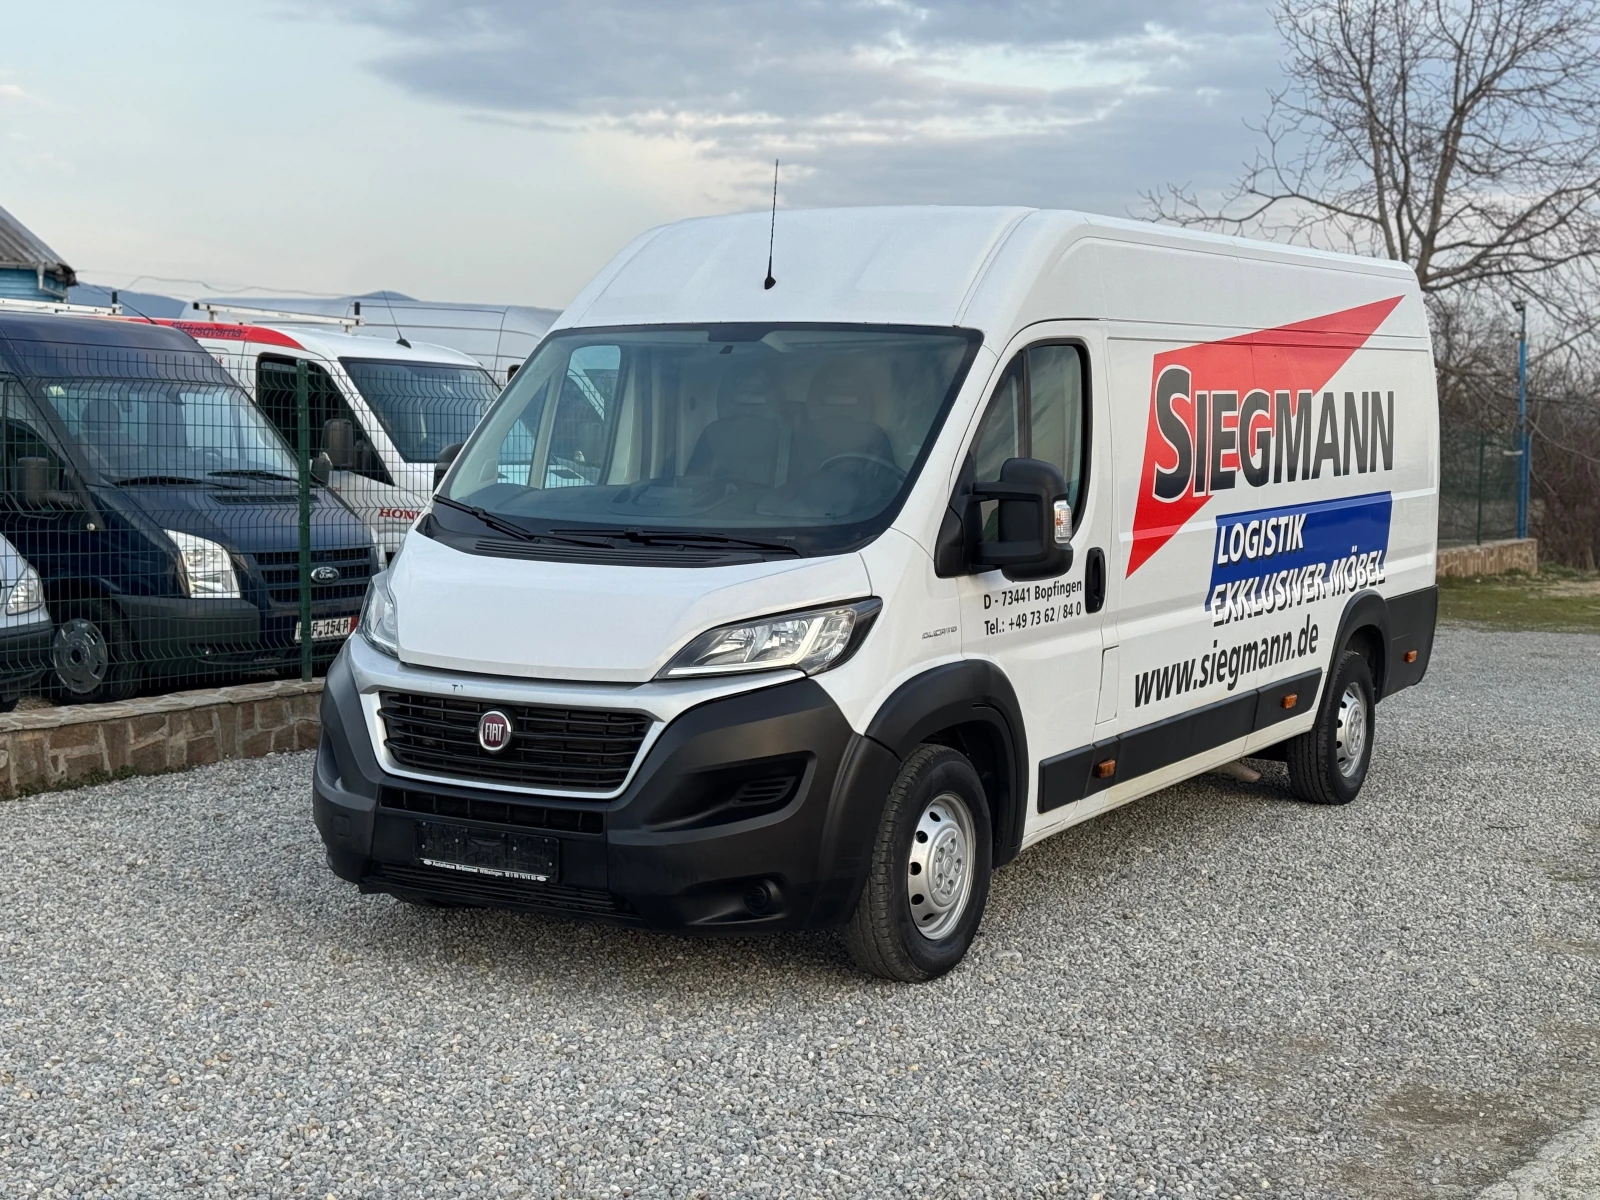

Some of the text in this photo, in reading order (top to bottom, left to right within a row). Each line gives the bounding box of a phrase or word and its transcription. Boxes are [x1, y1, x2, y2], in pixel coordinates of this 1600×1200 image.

[1152, 365, 1395, 503] SIEGMANN
[1217, 513, 1307, 569] LOGISTIK
[983, 594, 991, 609] D
[1001, 587, 1031, 607] 73441
[1034, 580, 1082, 602] Bopfingen
[1211, 545, 1386, 627] EXKLUSIVER MÖBEL
[984, 618, 1005, 636] Tel.:
[1008, 613, 1028, 631] +49
[1030, 611, 1041, 626] 73
[1044, 606, 1055, 623] 62
[1063, 602, 1074, 619] 84
[1075, 601, 1082, 616] 0
[1134, 614, 1319, 708] www.siegmann.de
[485, 722, 504, 742] FIAT
